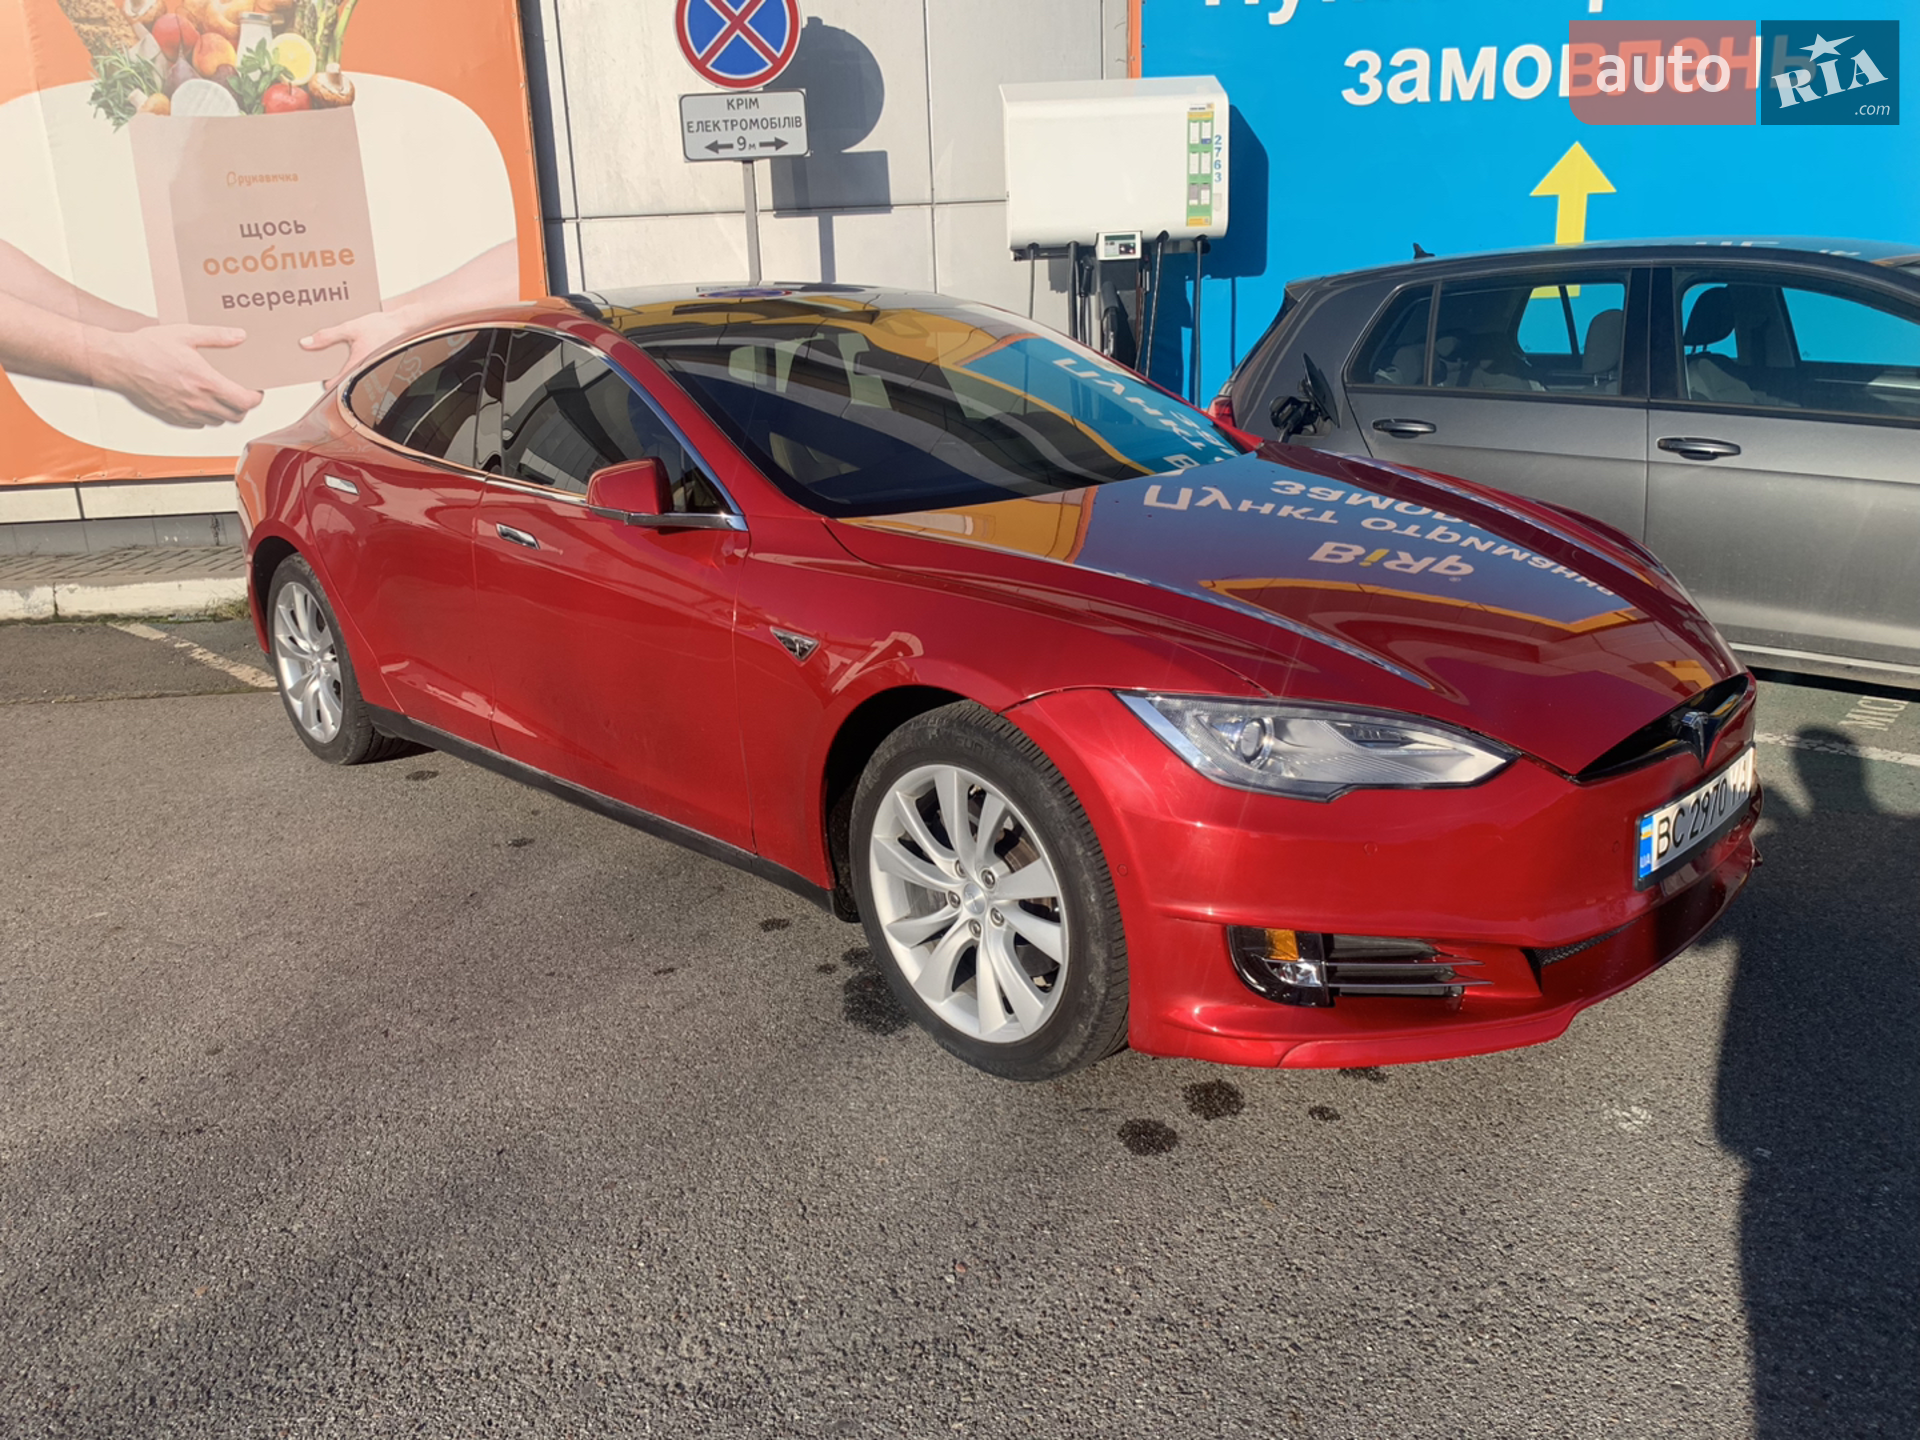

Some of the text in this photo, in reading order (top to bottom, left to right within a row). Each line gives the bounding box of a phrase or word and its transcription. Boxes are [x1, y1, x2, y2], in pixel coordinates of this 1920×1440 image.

[726, 98, 760, 110] КРІМ
[686, 116, 803, 133] ЕЛЕКТРОМОБІЛІВ
[239, 220, 307, 240] щось
[203, 245, 356, 276] особливе
[221, 281, 350, 311] всередині
[1655, 807, 1686, 861] BC
[1688, 777, 1728, 841] 2970
